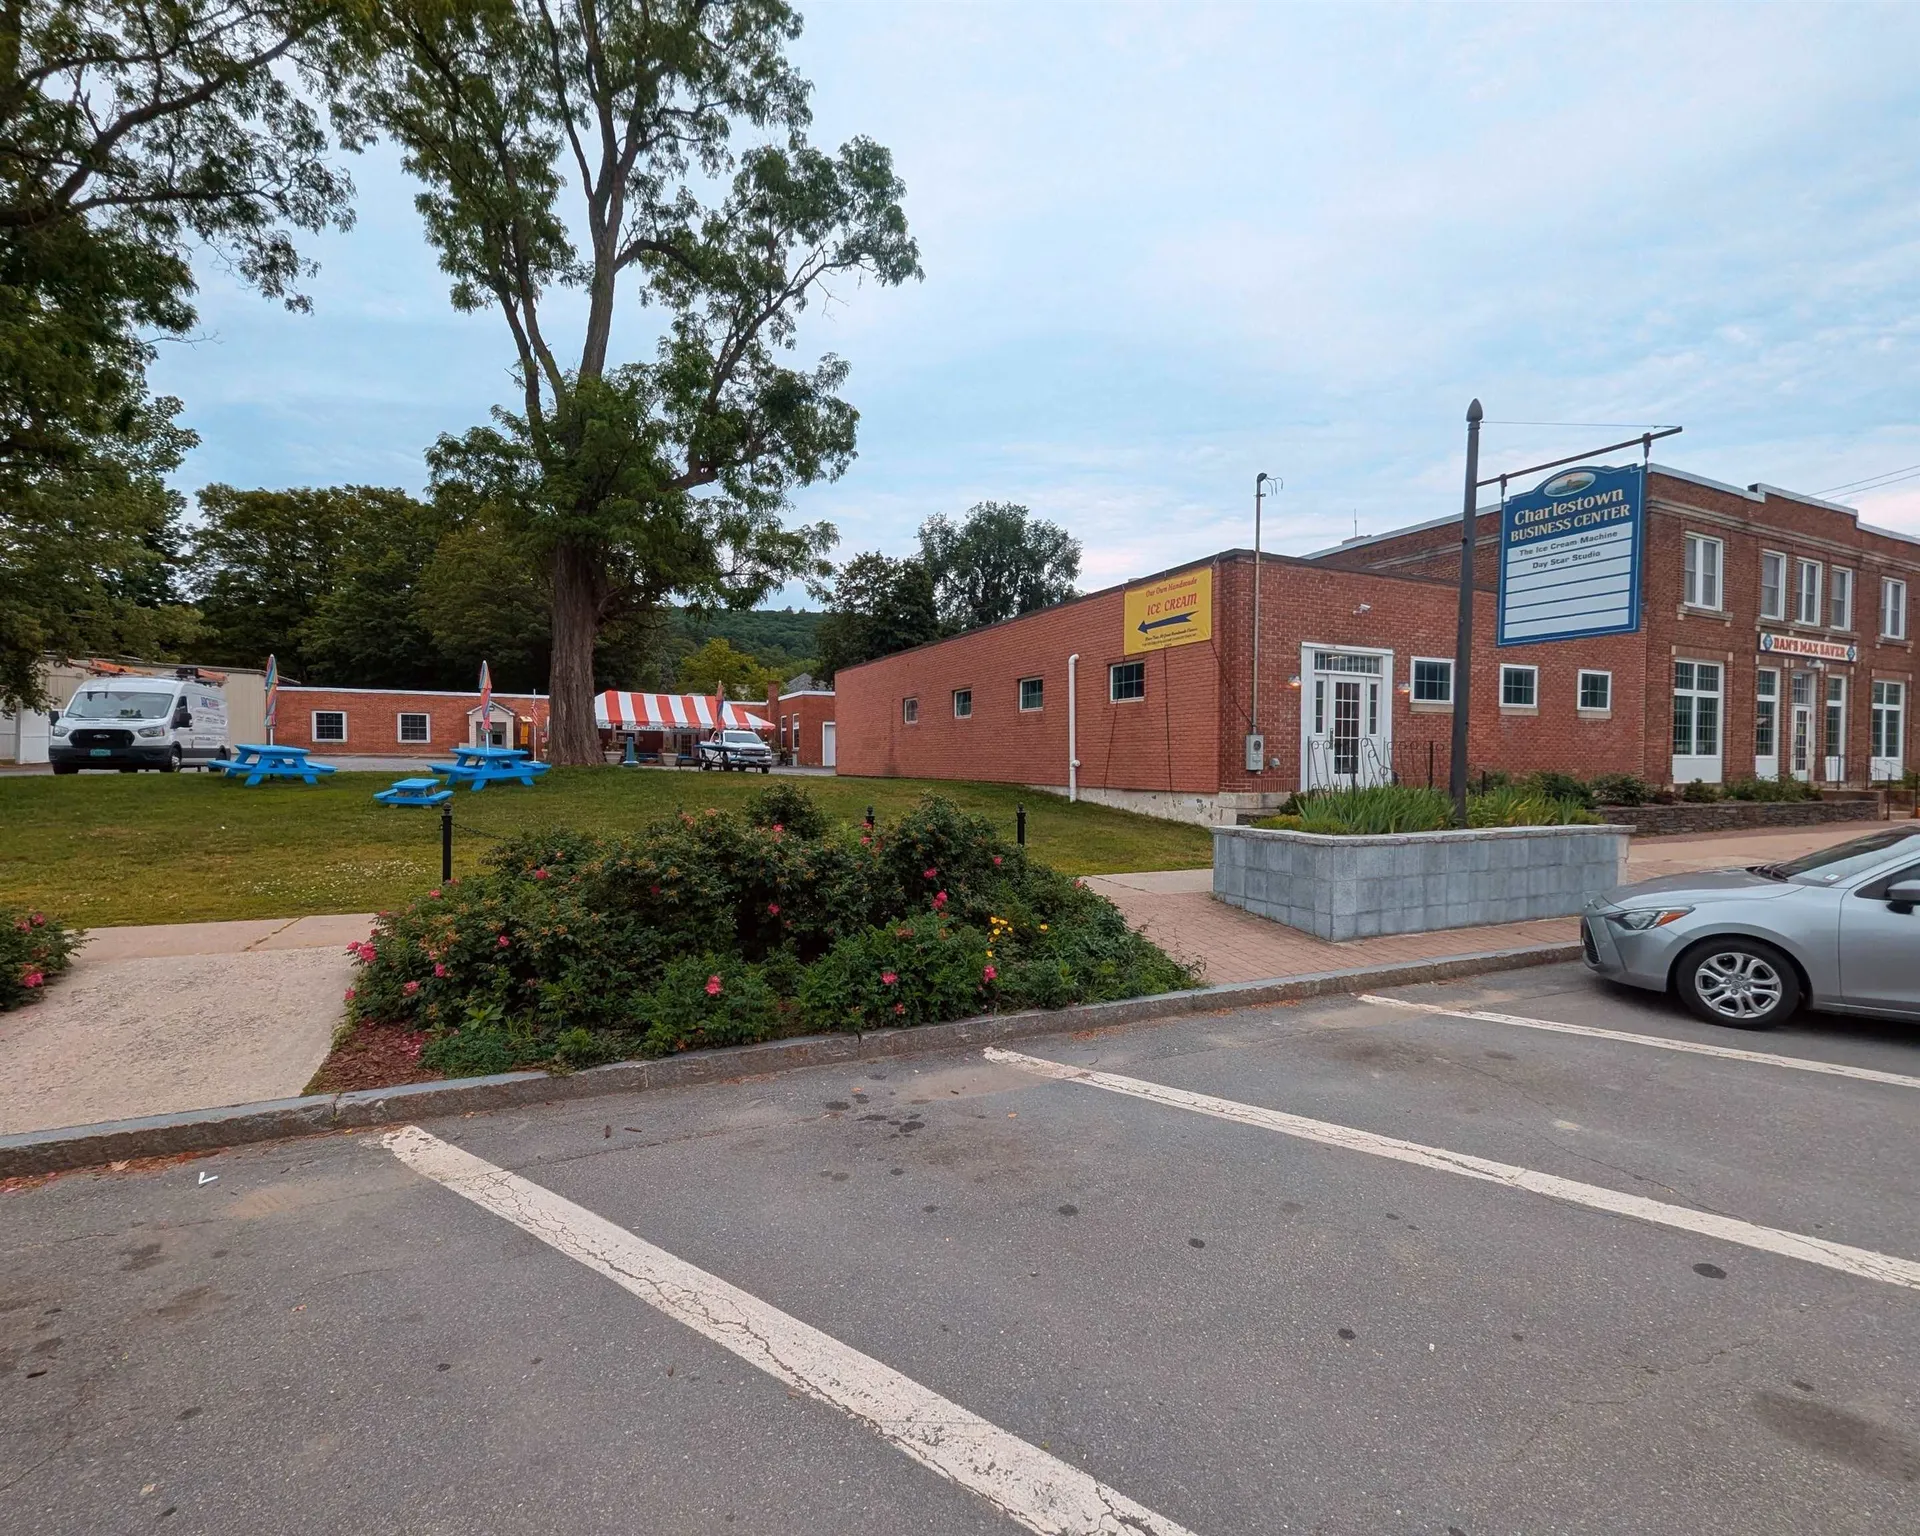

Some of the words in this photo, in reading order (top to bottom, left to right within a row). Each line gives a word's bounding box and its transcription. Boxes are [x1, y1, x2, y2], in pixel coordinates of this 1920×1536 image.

[1514, 489, 1624, 525] Charlestown
[1511, 518, 1571, 542] BUSINESS
[1574, 504, 1630, 527] CENTER
[1519, 548, 1533, 557] The
[1550, 540, 1577, 550] Cream
[1580, 531, 1618, 544] Machine
[1532, 561, 1548, 569] Day
[1550, 556, 1570, 566] Star
[1572, 550, 1600, 561] Studio
[1147, 602, 1161, 616] ICE
[1164, 592, 1197, 611] CREAM
[1773, 637, 1798, 651] DAN'S
[1800, 641, 1819, 655] MAX
[1819, 644, 1846, 658] SAVER
